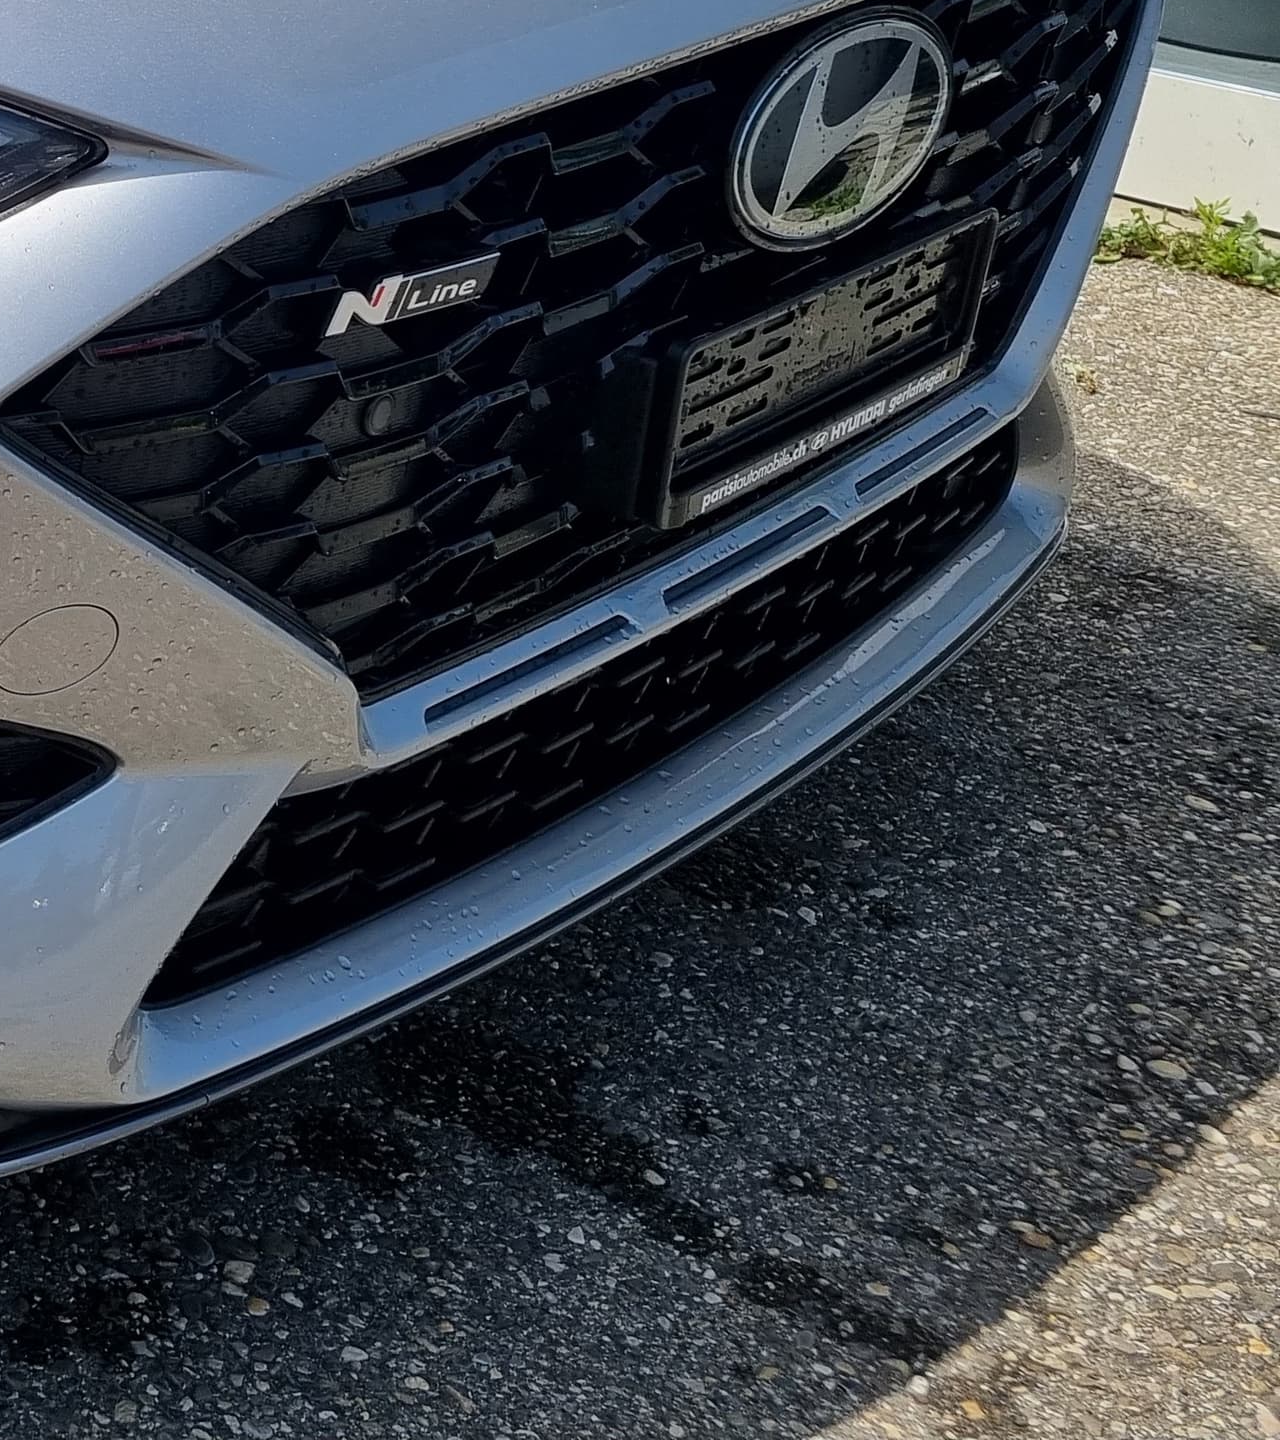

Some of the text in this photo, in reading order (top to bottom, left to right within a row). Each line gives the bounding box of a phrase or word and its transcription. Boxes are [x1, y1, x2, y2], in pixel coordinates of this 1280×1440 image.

[324, 274, 478, 338] N Line
[700, 440, 807, 513] parisiautomobile.ch
[830, 400, 886, 441] HYUNDAI
